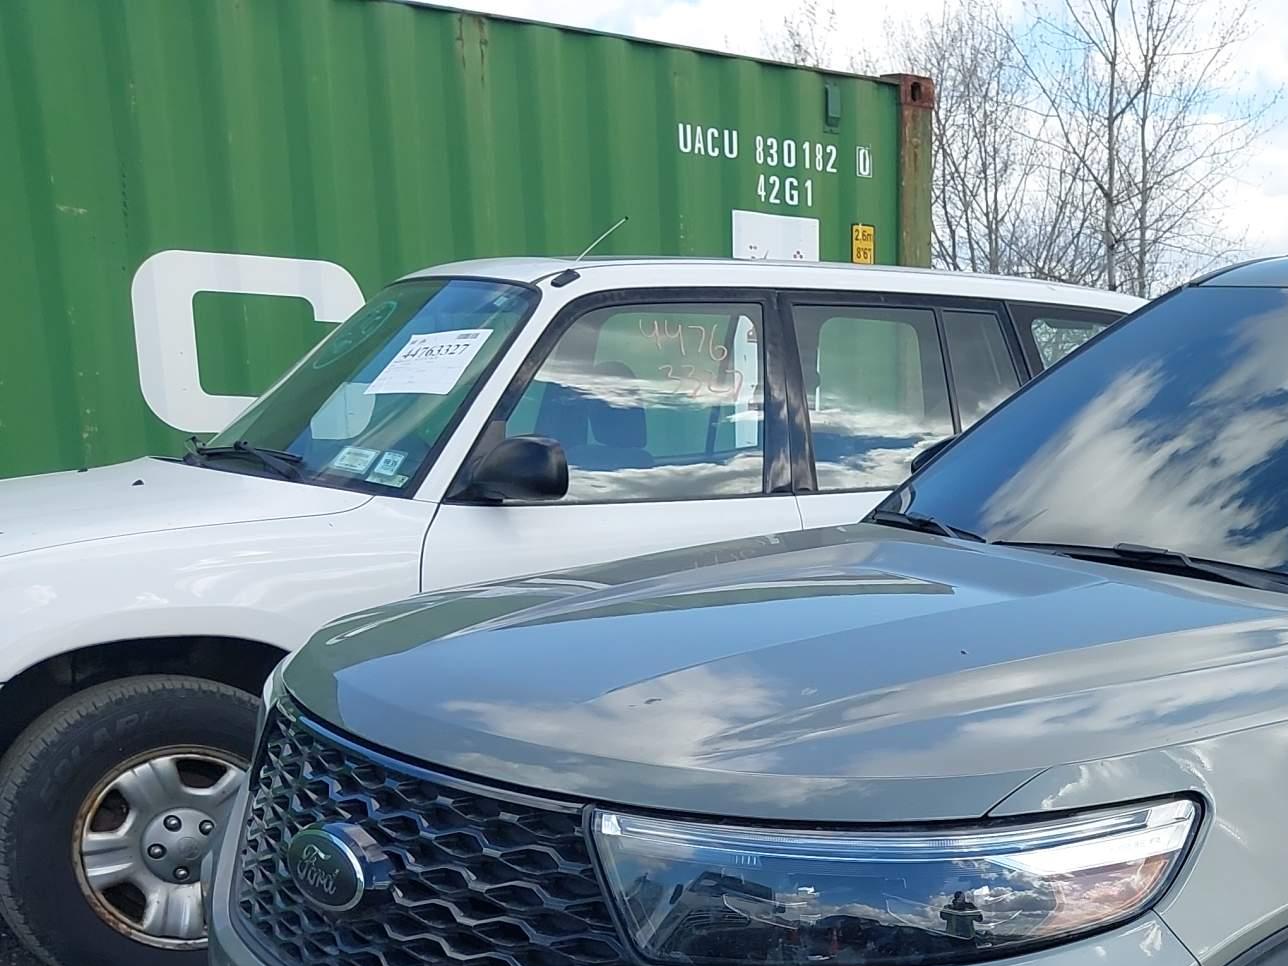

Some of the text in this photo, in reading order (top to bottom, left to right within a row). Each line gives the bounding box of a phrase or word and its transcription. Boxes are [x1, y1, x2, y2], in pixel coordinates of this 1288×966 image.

[678, 122, 738, 159] UACU
[755, 135, 838, 174] 830182
[757, 173, 813, 207] 42G1
[402, 342, 470, 360] 44763327
[639, 319, 728, 361] 4476
[658, 363, 744, 402] 3327
[296, 844, 340, 895] Ford
